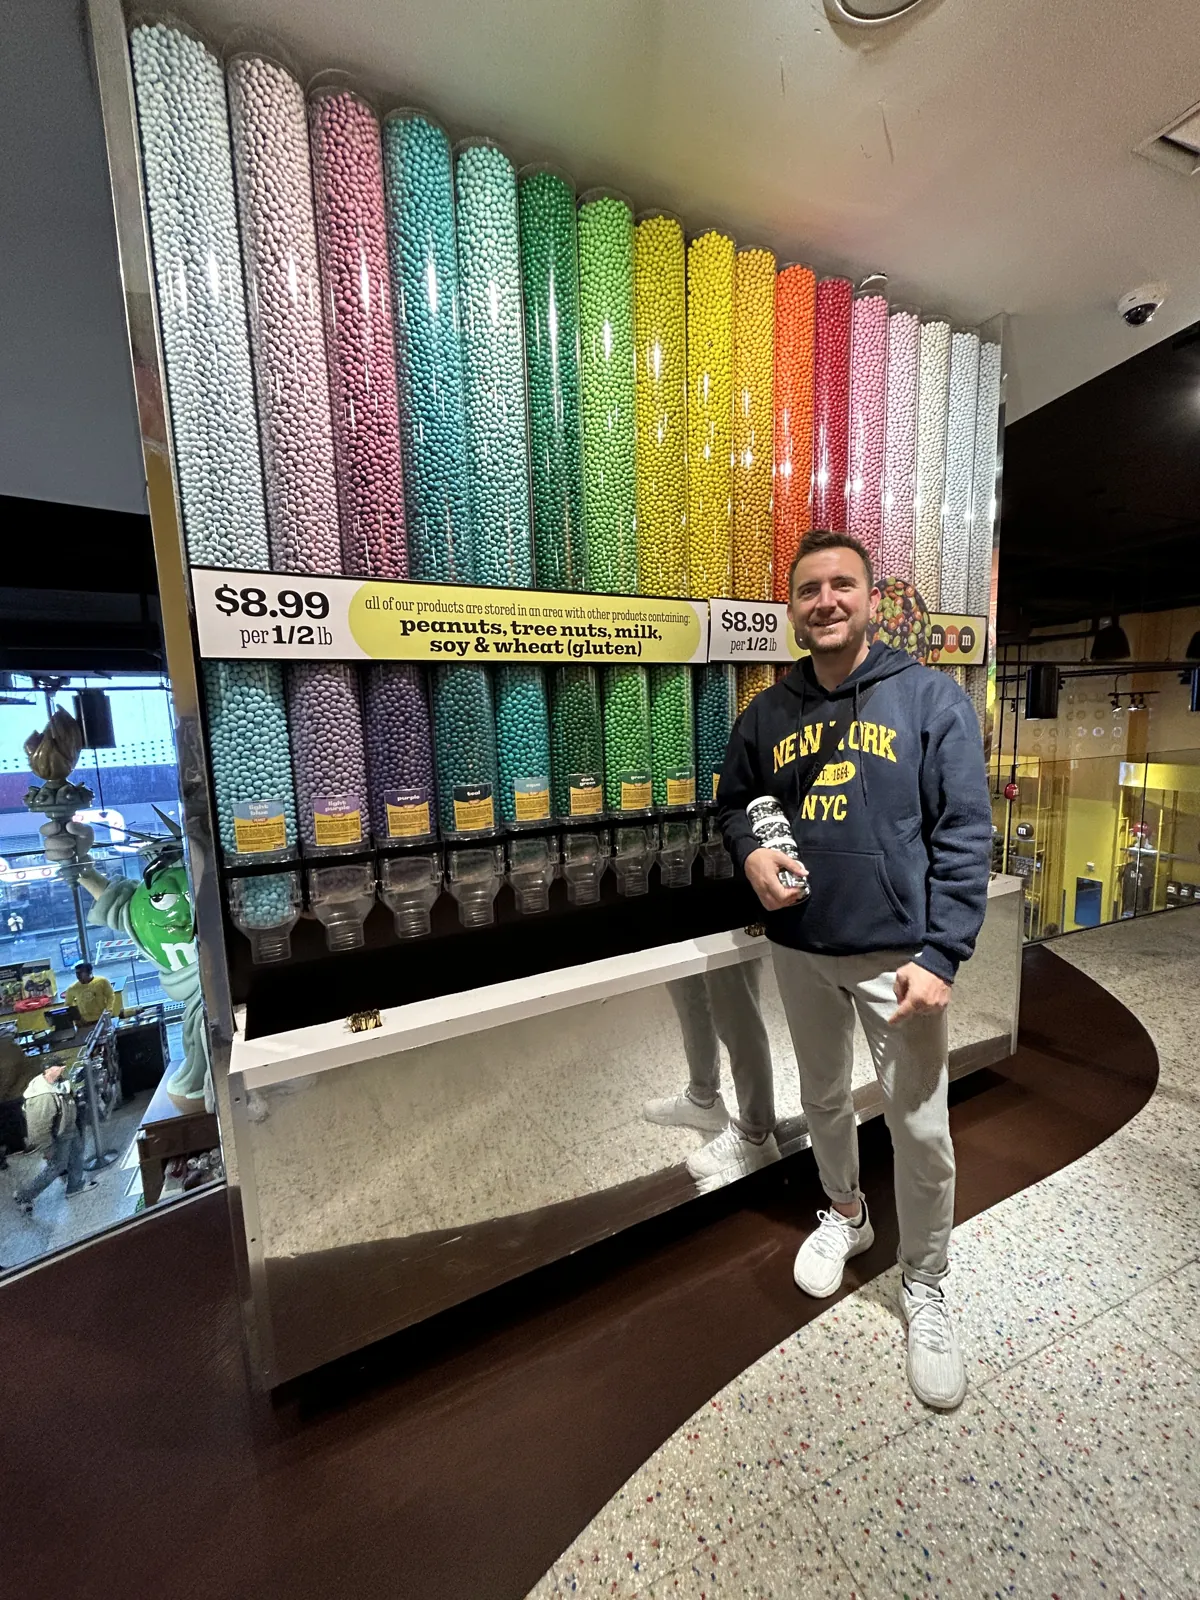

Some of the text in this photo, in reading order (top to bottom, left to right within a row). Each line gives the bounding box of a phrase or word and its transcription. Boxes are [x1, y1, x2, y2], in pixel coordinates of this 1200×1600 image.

[214, 583, 330, 620] $8.99
[365, 596, 690, 626] all of our products are stored in an area with other products containing:
[400, 619, 663, 641] peanuts, tree nuts, milk,
[721, 609, 778, 633] $8.99
[240, 625, 333, 648] per 1/2 lb
[430, 636, 643, 658] soy & wheat (gluten)
[730, 637, 777, 654] per 1/2 lb
[931, 633, 971, 646] m m m
[773, 720, 897, 774] NEW ORK
[801, 794, 848, 821] NYC
